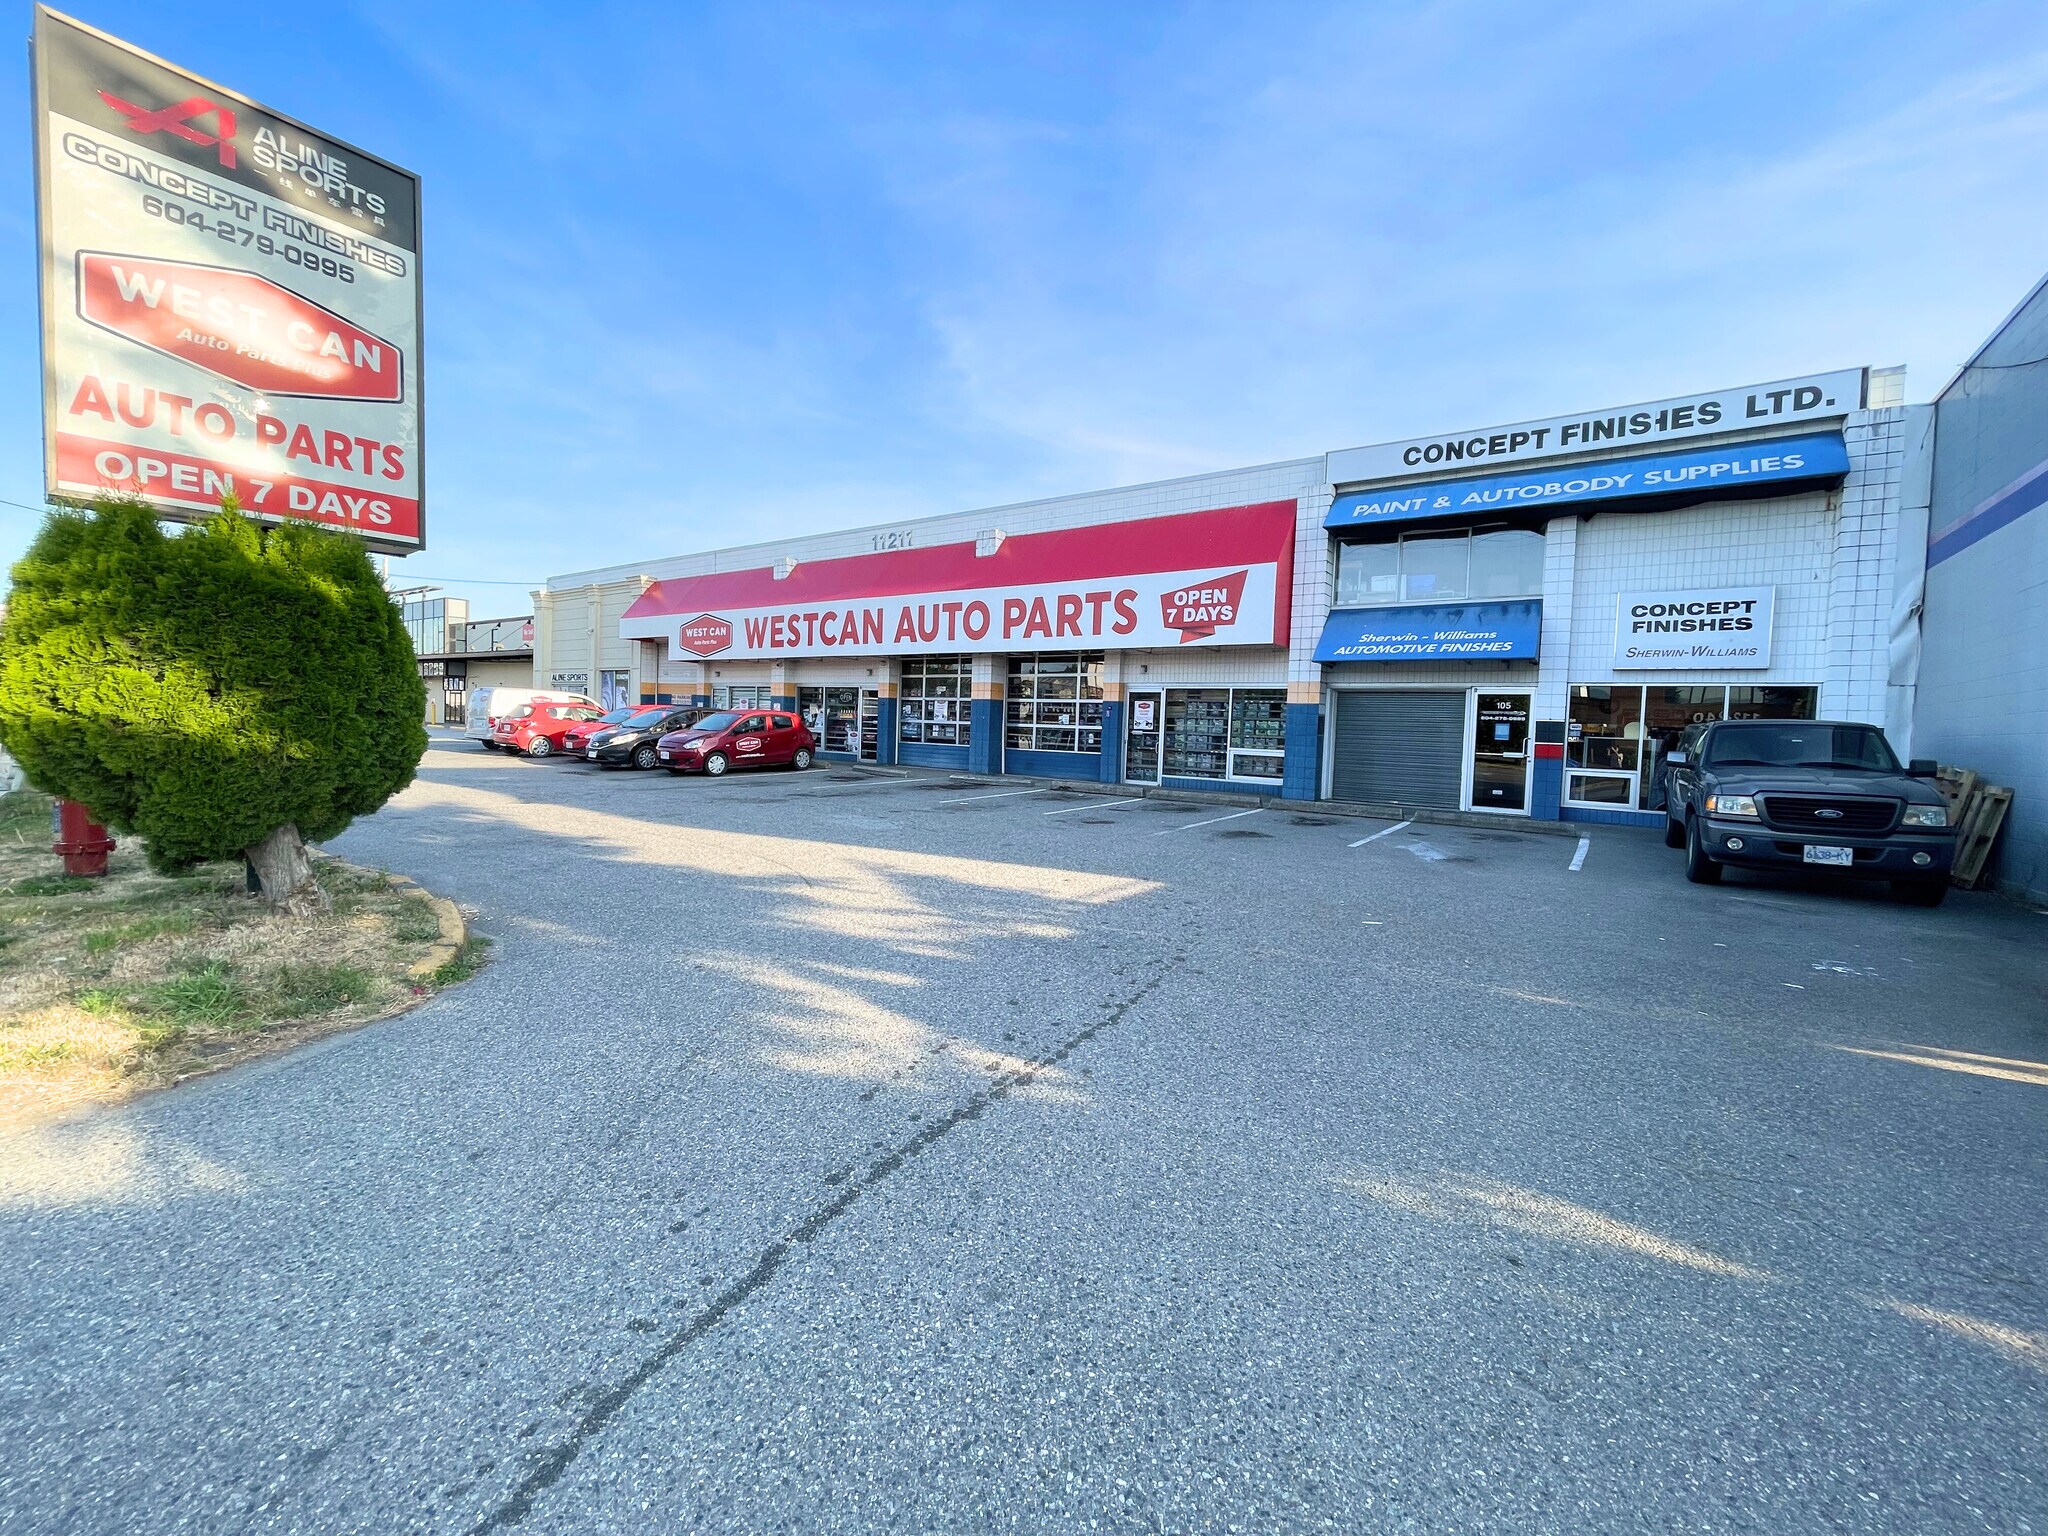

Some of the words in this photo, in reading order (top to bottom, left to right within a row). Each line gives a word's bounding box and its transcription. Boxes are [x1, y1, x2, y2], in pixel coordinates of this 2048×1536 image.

[253, 126, 347, 181] ALINE
[252, 145, 386, 215] SPORTS
[63, 132, 257, 222] CONCEPT
[263, 205, 407, 278] FINISHES
[143, 194, 355, 284] 604-279-0995
[111, 265, 267, 338] WEST
[287, 320, 381, 373] CAN
[176, 328, 230, 351] Auto
[236, 343, 290, 367] Parts
[69, 375, 236, 444] AUTO
[256, 413, 405, 481] PARTS
[1403, 428, 1551, 466] CONCEPT
[1560, 401, 1722, 446] FINISHES
[1745, 385, 1835, 419] LTD.
[94, 450, 234, 497] OPEN
[249, 479, 273, 504] 7
[288, 485, 393, 525] DAYS
[1352, 498, 1428, 517] PAINT
[1432, 496, 1452, 509] &
[1460, 473, 1634, 505] AUTOBODY
[1643, 454, 1805, 485] SUPPLIES
[872, 530, 913, 551] 11211
[1166, 608, 1178, 623] 7
[1182, 605, 1234, 622] DAYS
[1173, 588, 1228, 606] OPEN
[1631, 600, 1757, 618] CONCEPT
[686, 628, 708, 637] WEST
[709, 627, 727, 636] CAN
[744, 608, 884, 649] WESTCAN
[894, 600, 991, 643] AUTO
[1002, 589, 1139, 640] PARTS
[1358, 632, 1419, 643] Sherwin
[1432, 630, 1498, 641] Williams
[1632, 617, 1753, 634] FINISHES
[1333, 643, 1438, 656] AUTOMOTIVE
[1439, 641, 1513, 653] FINISHES
[552, 673, 567, 682] ALINE
[567, 673, 588, 681] SPORTS
[1496, 701, 1512, 710] 105
